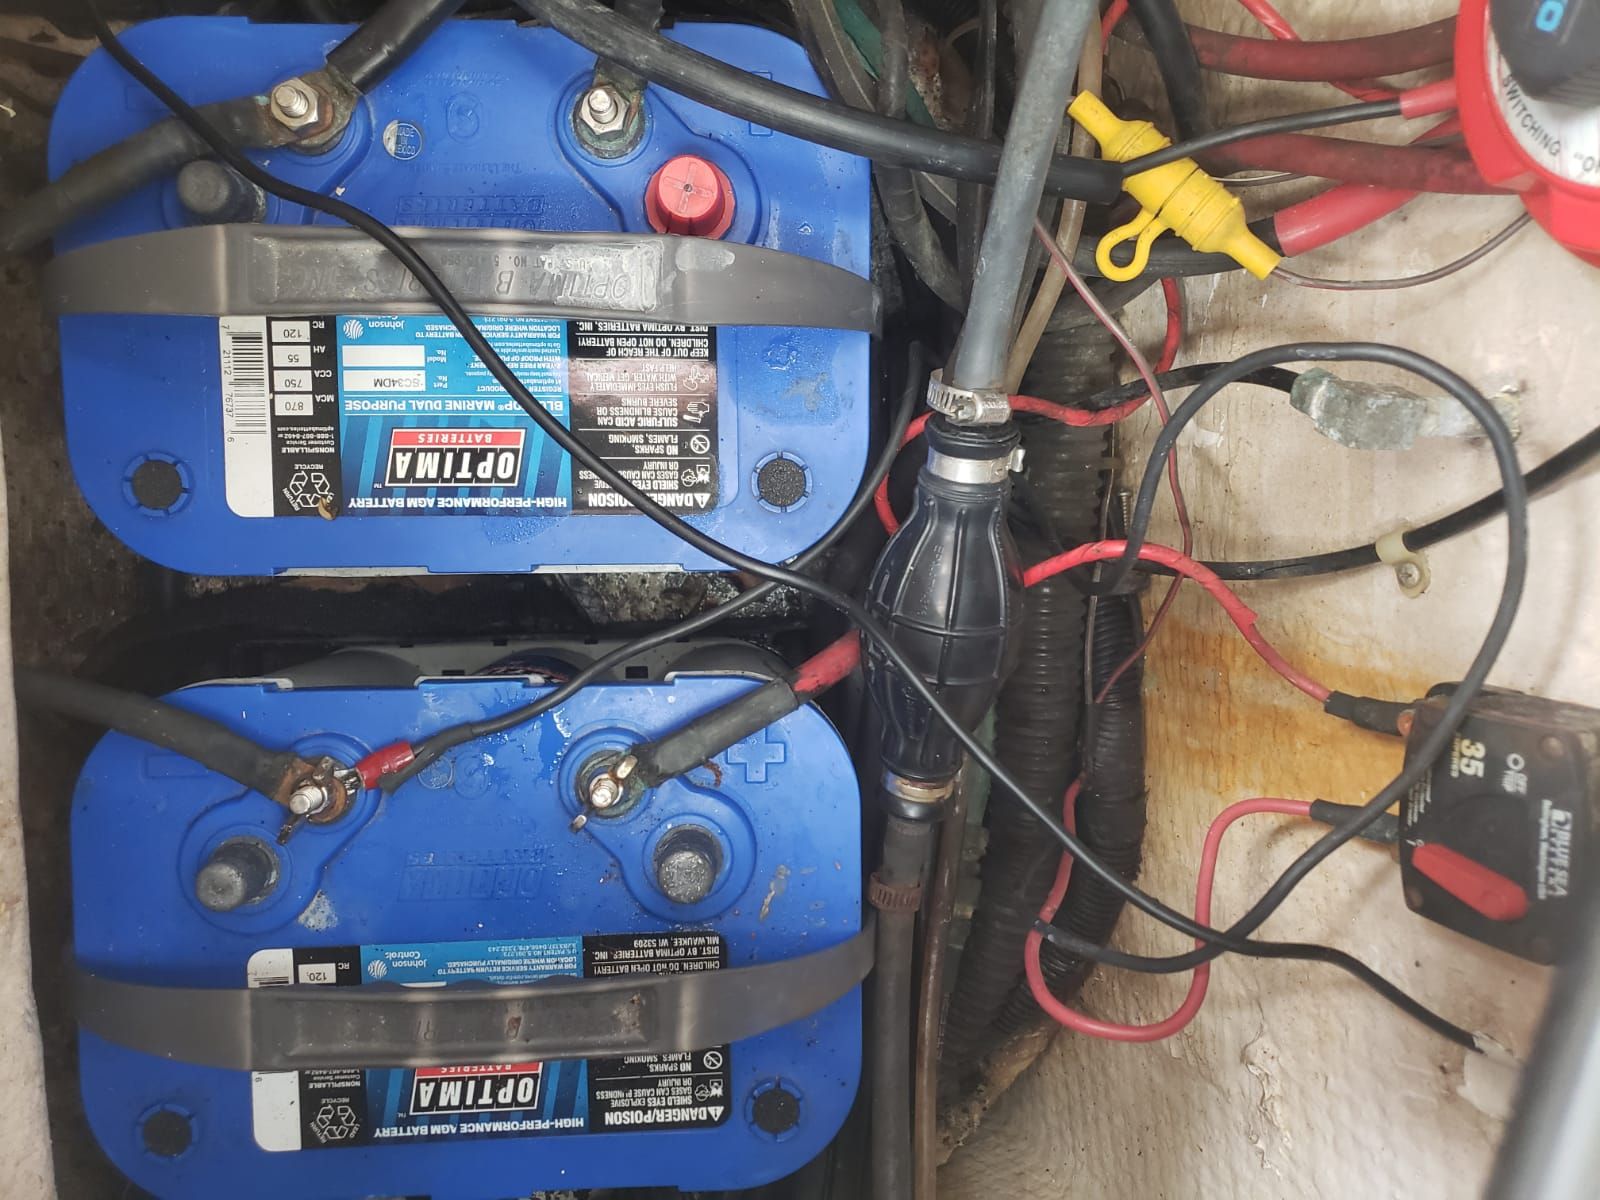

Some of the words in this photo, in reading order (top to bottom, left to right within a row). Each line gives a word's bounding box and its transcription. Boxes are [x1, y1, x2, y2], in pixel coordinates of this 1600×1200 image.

[1503, 74, 1561, 157] SWITCHING
[1574, 152, 1600, 173] "O
[368, 320, 405, 330] Johnson
[576, 321, 593, 331] INC.
[595, 321, 640, 331] BATTERIES,
[283, 329, 302, 338] 120
[578, 337, 615, 346] BATTERY!
[617, 337, 636, 346] OPEN
[638, 338, 654, 347] NOT
[656, 338, 666, 347] DO
[668, 338, 708, 347] CHILDREN.
[313, 345, 325, 353] AH
[606, 348, 616, 356] OF
[618, 347, 643, 356] REACH
[645, 348, 660, 356] THE
[661, 348, 671, 356] OF
[673, 348, 688, 356] OUT
[690, 348, 708, 357] KEEP
[222, 349, 232, 376] 21112
[287, 354, 299, 363] 55
[284, 379, 303, 388] 750
[373, 378, 420, 388] SC34DM
[655, 383, 678, 392] FLUSH
[315, 394, 334, 402] MCA
[649, 398, 678, 406] SEVERE
[224, 393, 234, 418] 76737
[285, 401, 304, 411] 870
[344, 400, 406, 410] PURPOSE
[408, 400, 442, 410] DUAL
[444, 400, 495, 410] MARINE
[539, 400, 563, 410] BLU
[597, 407, 608, 416] OR
[610, 406, 652, 416] BLINDNESS
[653, 407, 678, 416] CAUSE
[598, 416, 613, 425] CAN
[616, 417, 635, 427] ACID
[637, 417, 678, 427] SULFURIC
[418, 433, 493, 444] BATTERIES
[609, 434, 644, 443] SMOKING
[646, 433, 678, 443] FLAMES,
[632, 444, 665, 454] SPARKS,
[666, 445, 678, 455] NO
[395, 451, 516, 480] OPTIMA
[643, 461, 668, 469] INJURY
[669, 461, 678, 469] OR
[642, 470, 655, 479] CAN
[657, 470, 678, 479] GASES
[633, 480, 651, 490] EYES
[653, 480, 679, 490] SHIELD
[282, 487, 301, 512] RETURN
[348, 497, 403, 508] BATTERY
[404, 498, 436, 508] AGM
[437, 497, 567, 508] HIGH-PERFORMANCE
[588, 493, 694, 508] DANGEOISON
[1460, 738, 1485, 777] 35
[633, 939, 657, 948] 53209
[658, 938, 669, 947] WI
[670, 935, 719, 946] MILWAUKEE,
[592, 951, 608, 960] INC.
[655, 947, 685, 957] OPTIMA
[687, 947, 698, 957] BY
[699, 945, 720, 956] DIST.
[384, 951, 421, 961] Controls
[546, 956, 577, 964] LOCATION
[338, 962, 350, 970] RC
[392, 959, 427, 968] Johnson
[446, 959, 486, 968] PURCHASED.
[486, 958, 522, 966] ORIGINALLY
[528, 963, 564, 971] WARRANTY
[670, 961, 680, 970] DO
[681, 960, 720, 970] CHILDREN.
[447, 966, 476, 974] BATTERY
[476, 965, 501, 973] RETURN
[501, 964, 528, 972] SERVICE
[593, 964, 629, 975] BATTERY!
[630, 963, 651, 973] OPEN
[308, 972, 327, 981] 120
[647, 1062, 679, 1073] SPARKS,
[680, 1062, 692, 1072] NO
[308, 1080, 361, 1089] NONSPILLABLE
[657, 1078, 682, 1088] INJURY
[682, 1077, 692, 1086] OR
[418, 1077, 535, 1108] OPTIMA
[633, 1088, 655, 1098] CAUSE
[656, 1087, 670, 1097] CAN
[671, 1086, 692, 1096] GASES
[320, 1097, 350, 1105] RECYCLE
[610, 1098, 646, 1108] EXPLOSIVE
[646, 1097, 666, 1107] EYES
[667, 1095, 692, 1106] SHIELD
[604, 1106, 708, 1126] DANGER/POISON
[349, 1123, 360, 1138] LEAD
[429, 1124, 458, 1136] AGM
[459, 1117, 584, 1134] HIGH-PERFORMANCE
[372, 1124, 429, 1138] BATTERY
